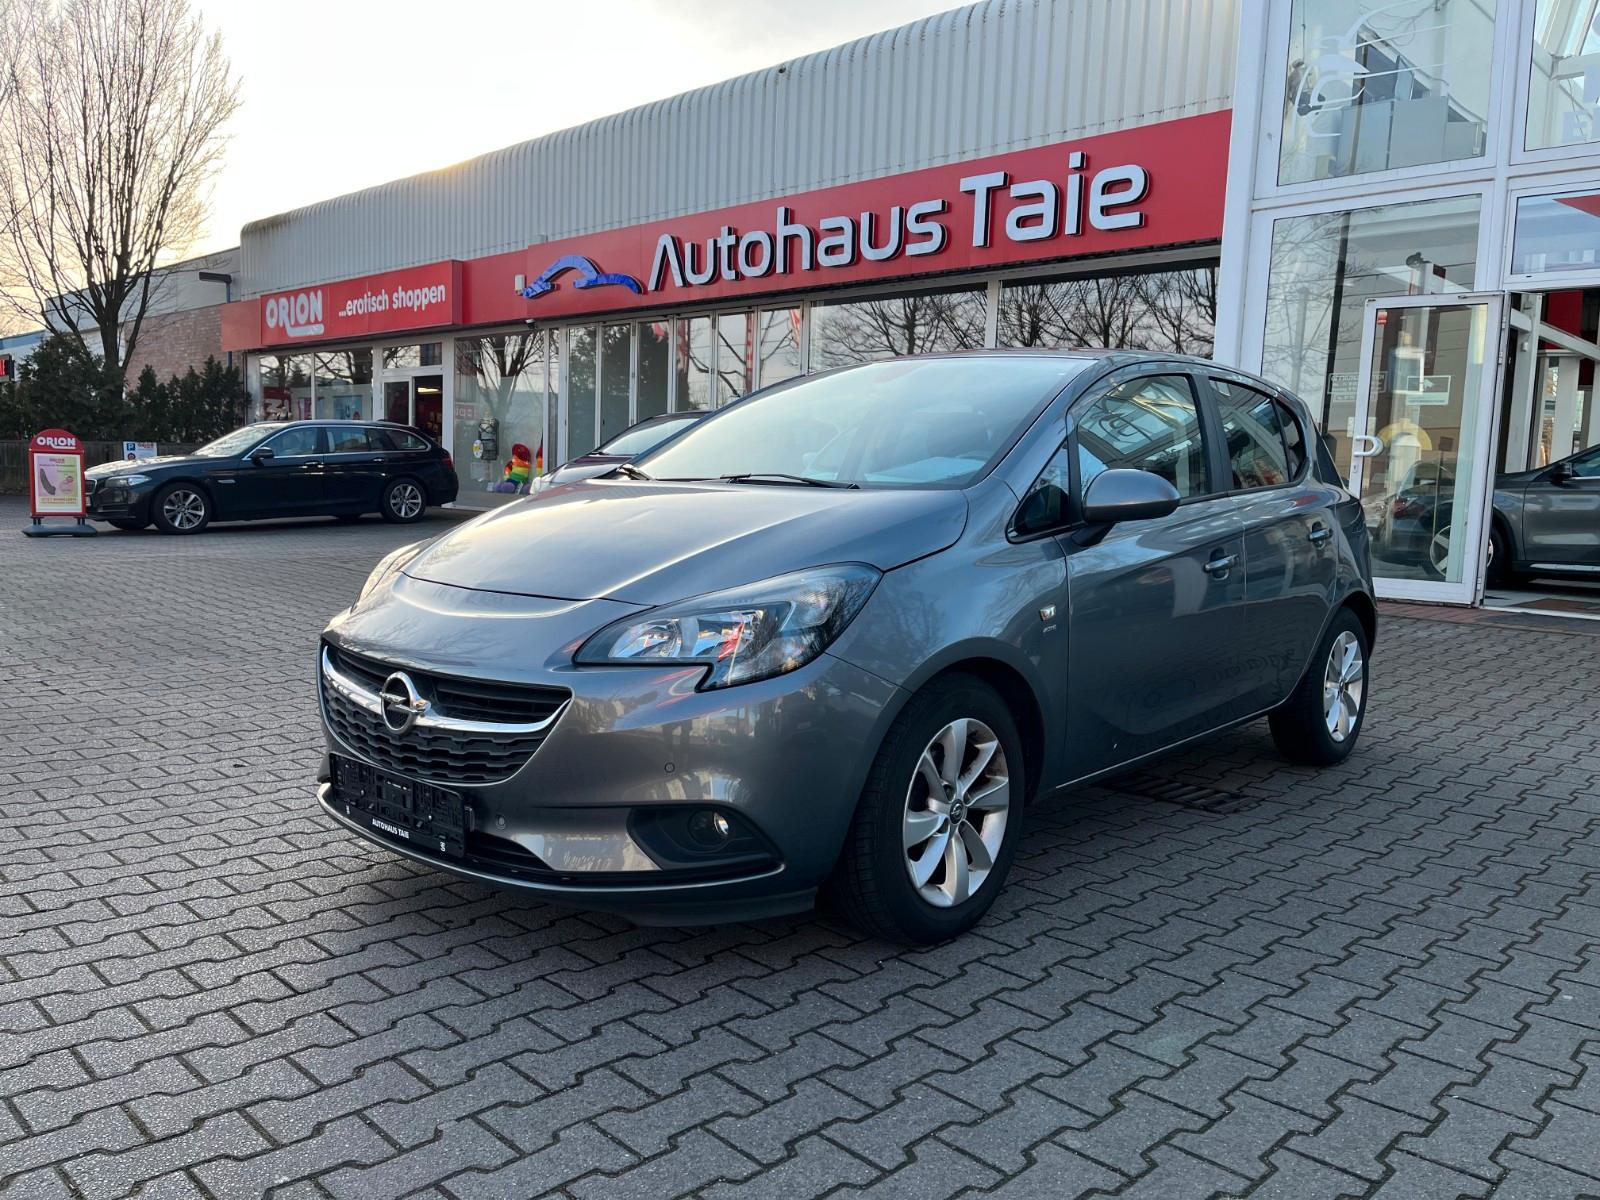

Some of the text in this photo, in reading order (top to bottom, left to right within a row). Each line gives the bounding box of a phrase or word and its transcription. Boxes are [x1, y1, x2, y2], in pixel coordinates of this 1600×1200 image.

[647, 150, 1149, 292] Autohaus Taie
[392, 284, 446, 312] shoppen
[265, 289, 325, 337] ORION
[36, 436, 76, 449] ORION
[372, 818, 410, 839] AUTOHAUS TAIE
